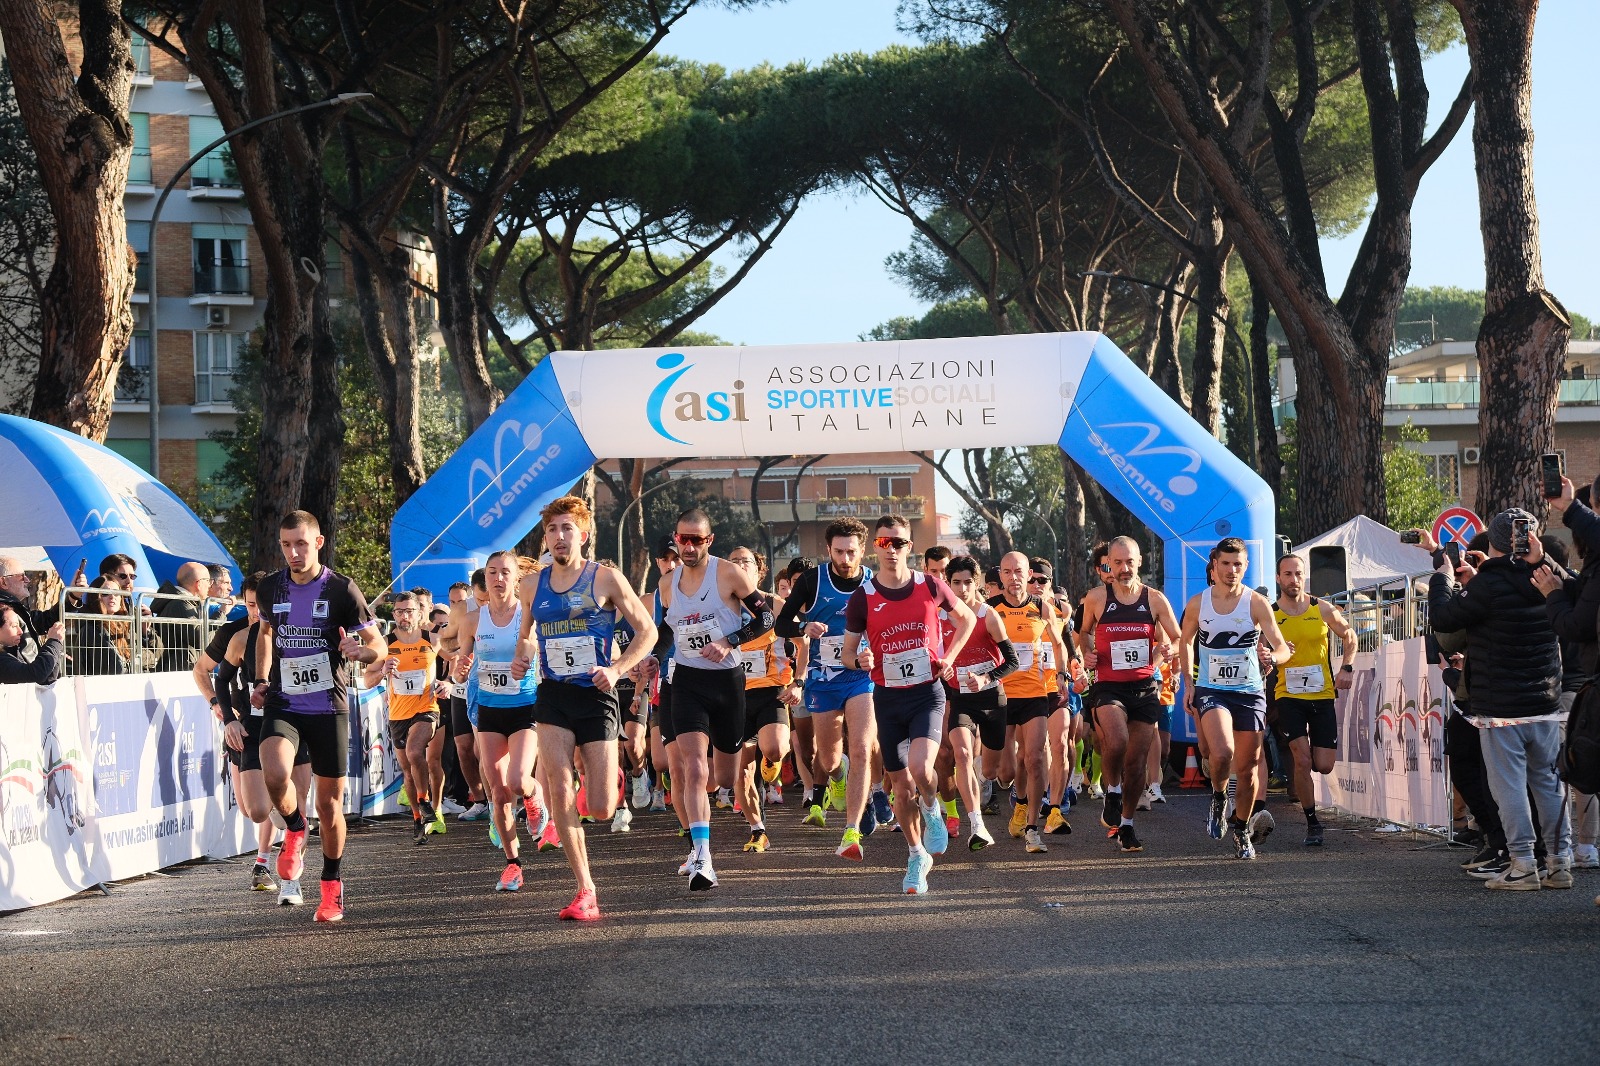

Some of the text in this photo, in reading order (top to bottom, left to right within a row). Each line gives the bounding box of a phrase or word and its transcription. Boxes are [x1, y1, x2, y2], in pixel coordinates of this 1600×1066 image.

[767, 359, 994, 384] ASSOCIAZIONI
[674, 379, 749, 422] asi
[769, 407, 997, 432] ITALIANE
[1087, 432, 1176, 513] syemme
[477, 444, 561, 528] syemme
[881, 621, 930, 640] RUNNERS
[687, 633, 712, 649] 334
[881, 637, 930, 653] CIAMPINO
[565, 651, 575, 667] 5
[1124, 650, 1139, 663] 59
[292, 668, 320, 685] 346
[899, 662, 915, 678] 12
[1218, 665, 1240, 678] 407
[404, 679, 414, 690] 11
[487, 673, 508, 687] 150
[1301, 676, 1309, 687] 7
[103, 809, 195, 849] www.asinazionale.it
